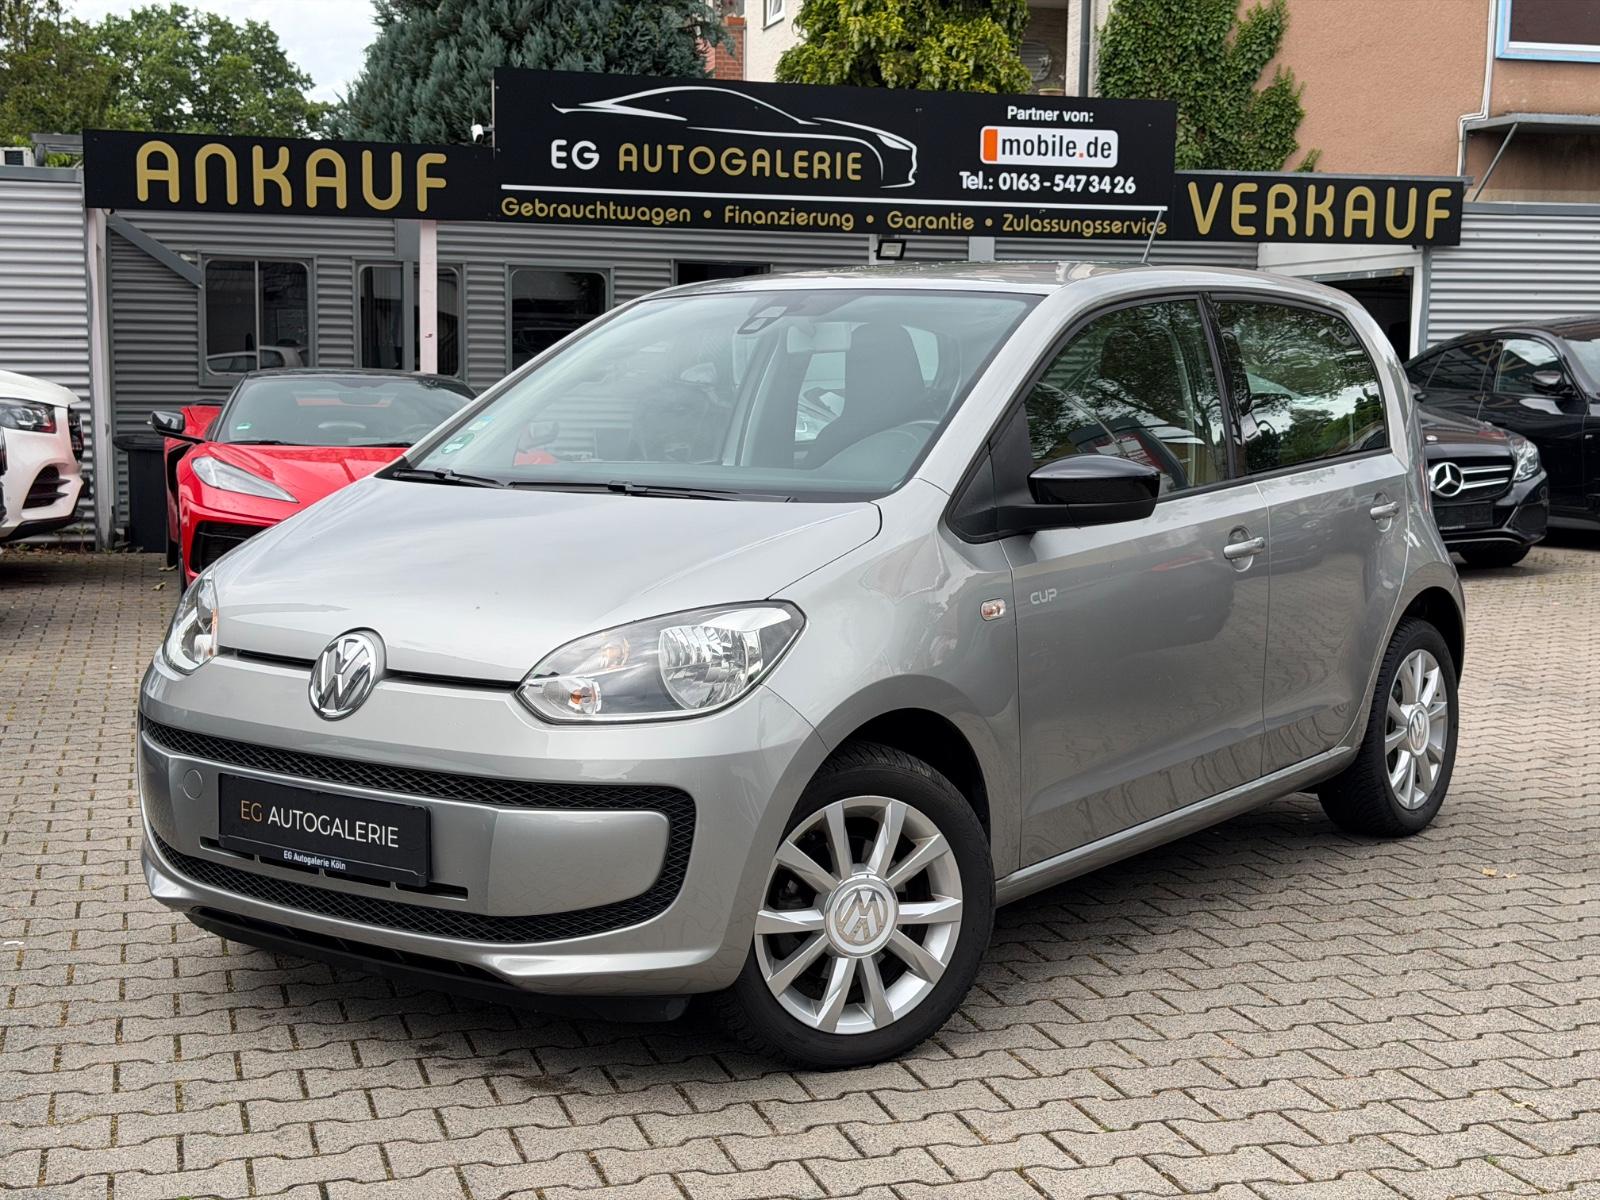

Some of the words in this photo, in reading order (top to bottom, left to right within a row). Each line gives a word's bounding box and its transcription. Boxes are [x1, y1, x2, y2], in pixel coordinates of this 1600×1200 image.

[1007, 105, 1059, 122] Partner
[1063, 109, 1094, 123] von:
[551, 139, 600, 170] EG
[618, 143, 862, 181] AUTOGALERIE
[1001, 134, 1112, 159] mobile.de
[136, 140, 447, 212] ANKAUF
[959, 171, 994, 190] Tel.:
[501, 197, 691, 226] Gebrauchtwagen
[724, 205, 854, 231] Finanzierung
[887, 211, 974, 231] Garantie
[1003, 214, 1167, 237] Zulassungsservice
[1187, 181, 1452, 239] VERKAUF
[1030, 588, 1057, 605] CUP
[240, 799, 263, 822] EG
[267, 806, 399, 848] AUTOGALERIE
[283, 850, 293, 860] EG
[293, 852, 329, 867] Autogalerie
[330, 859, 346, 870] Köln
